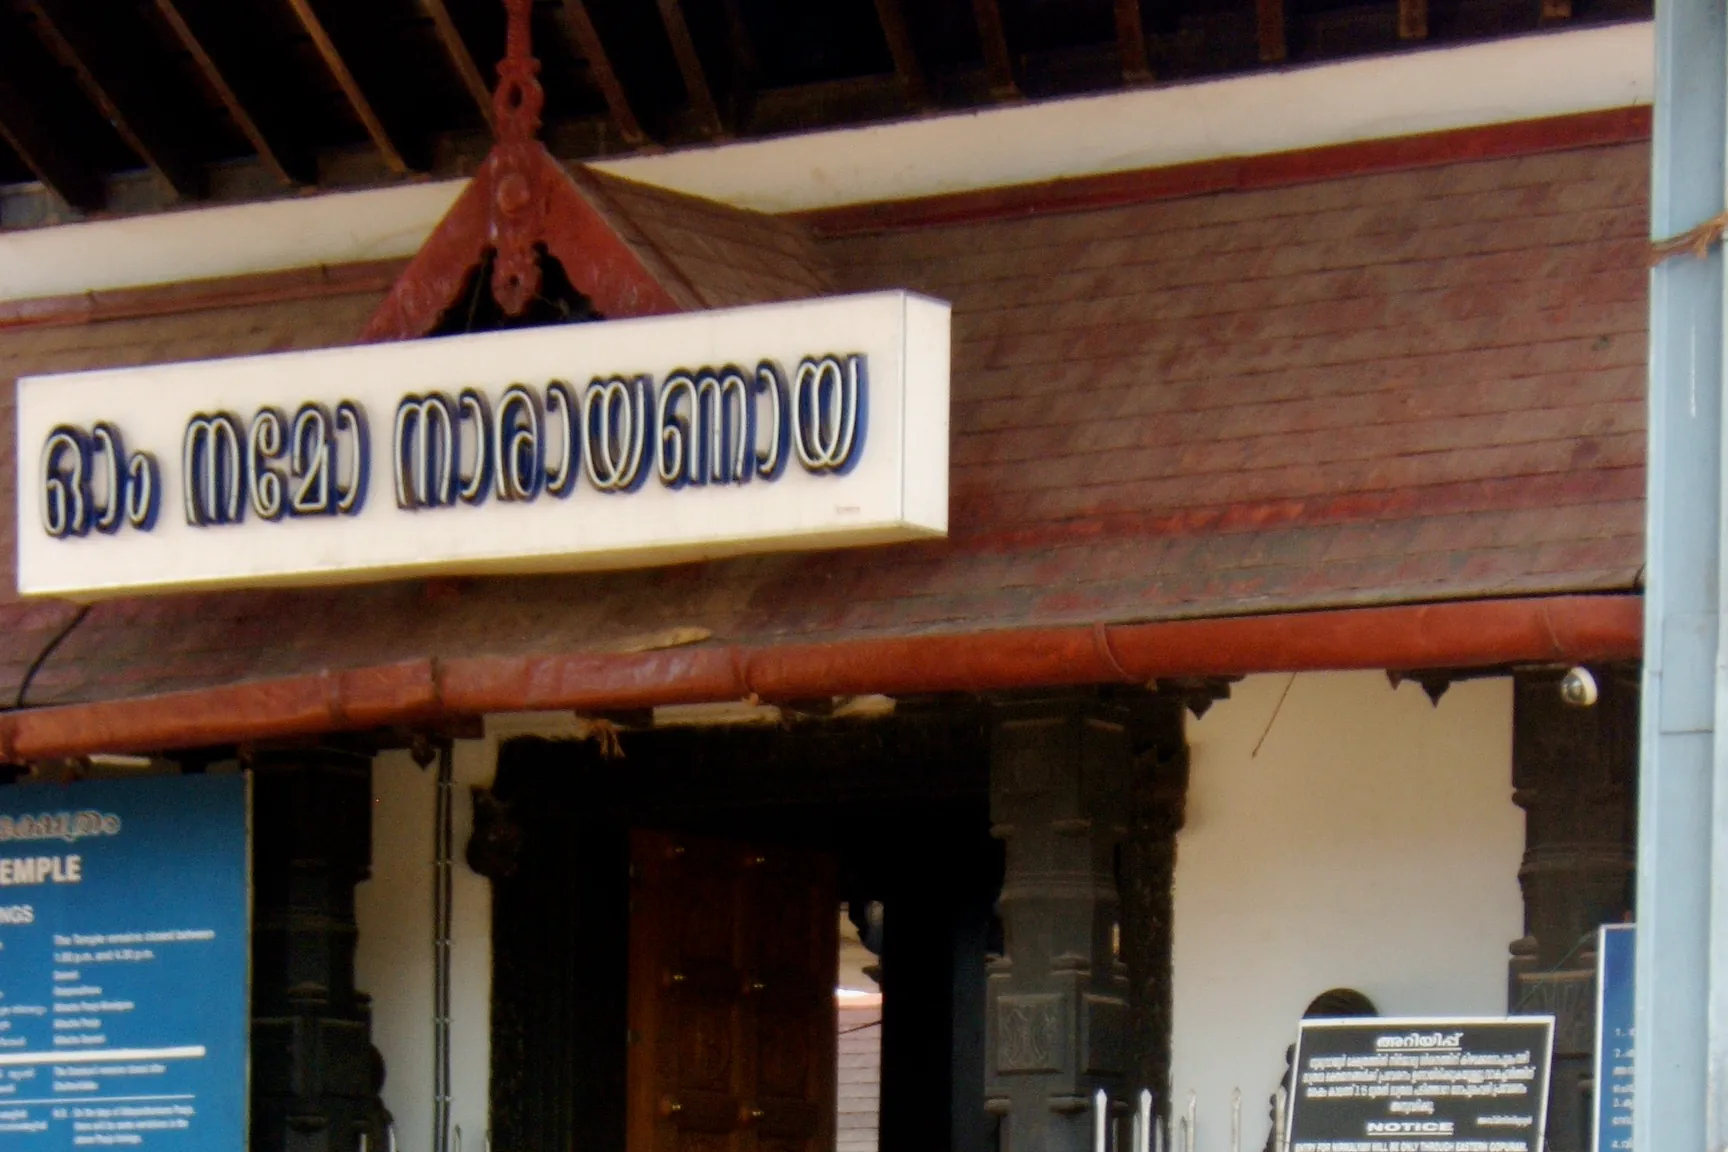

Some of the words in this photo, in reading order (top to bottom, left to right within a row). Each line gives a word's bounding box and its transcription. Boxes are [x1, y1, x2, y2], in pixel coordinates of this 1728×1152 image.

[38, 420, 162, 540] ഓം
[183, 399, 370, 527] നമോ
[394, 352, 868, 512] നാരായണായ
[1366, 1122, 1454, 1132] NOTICE
